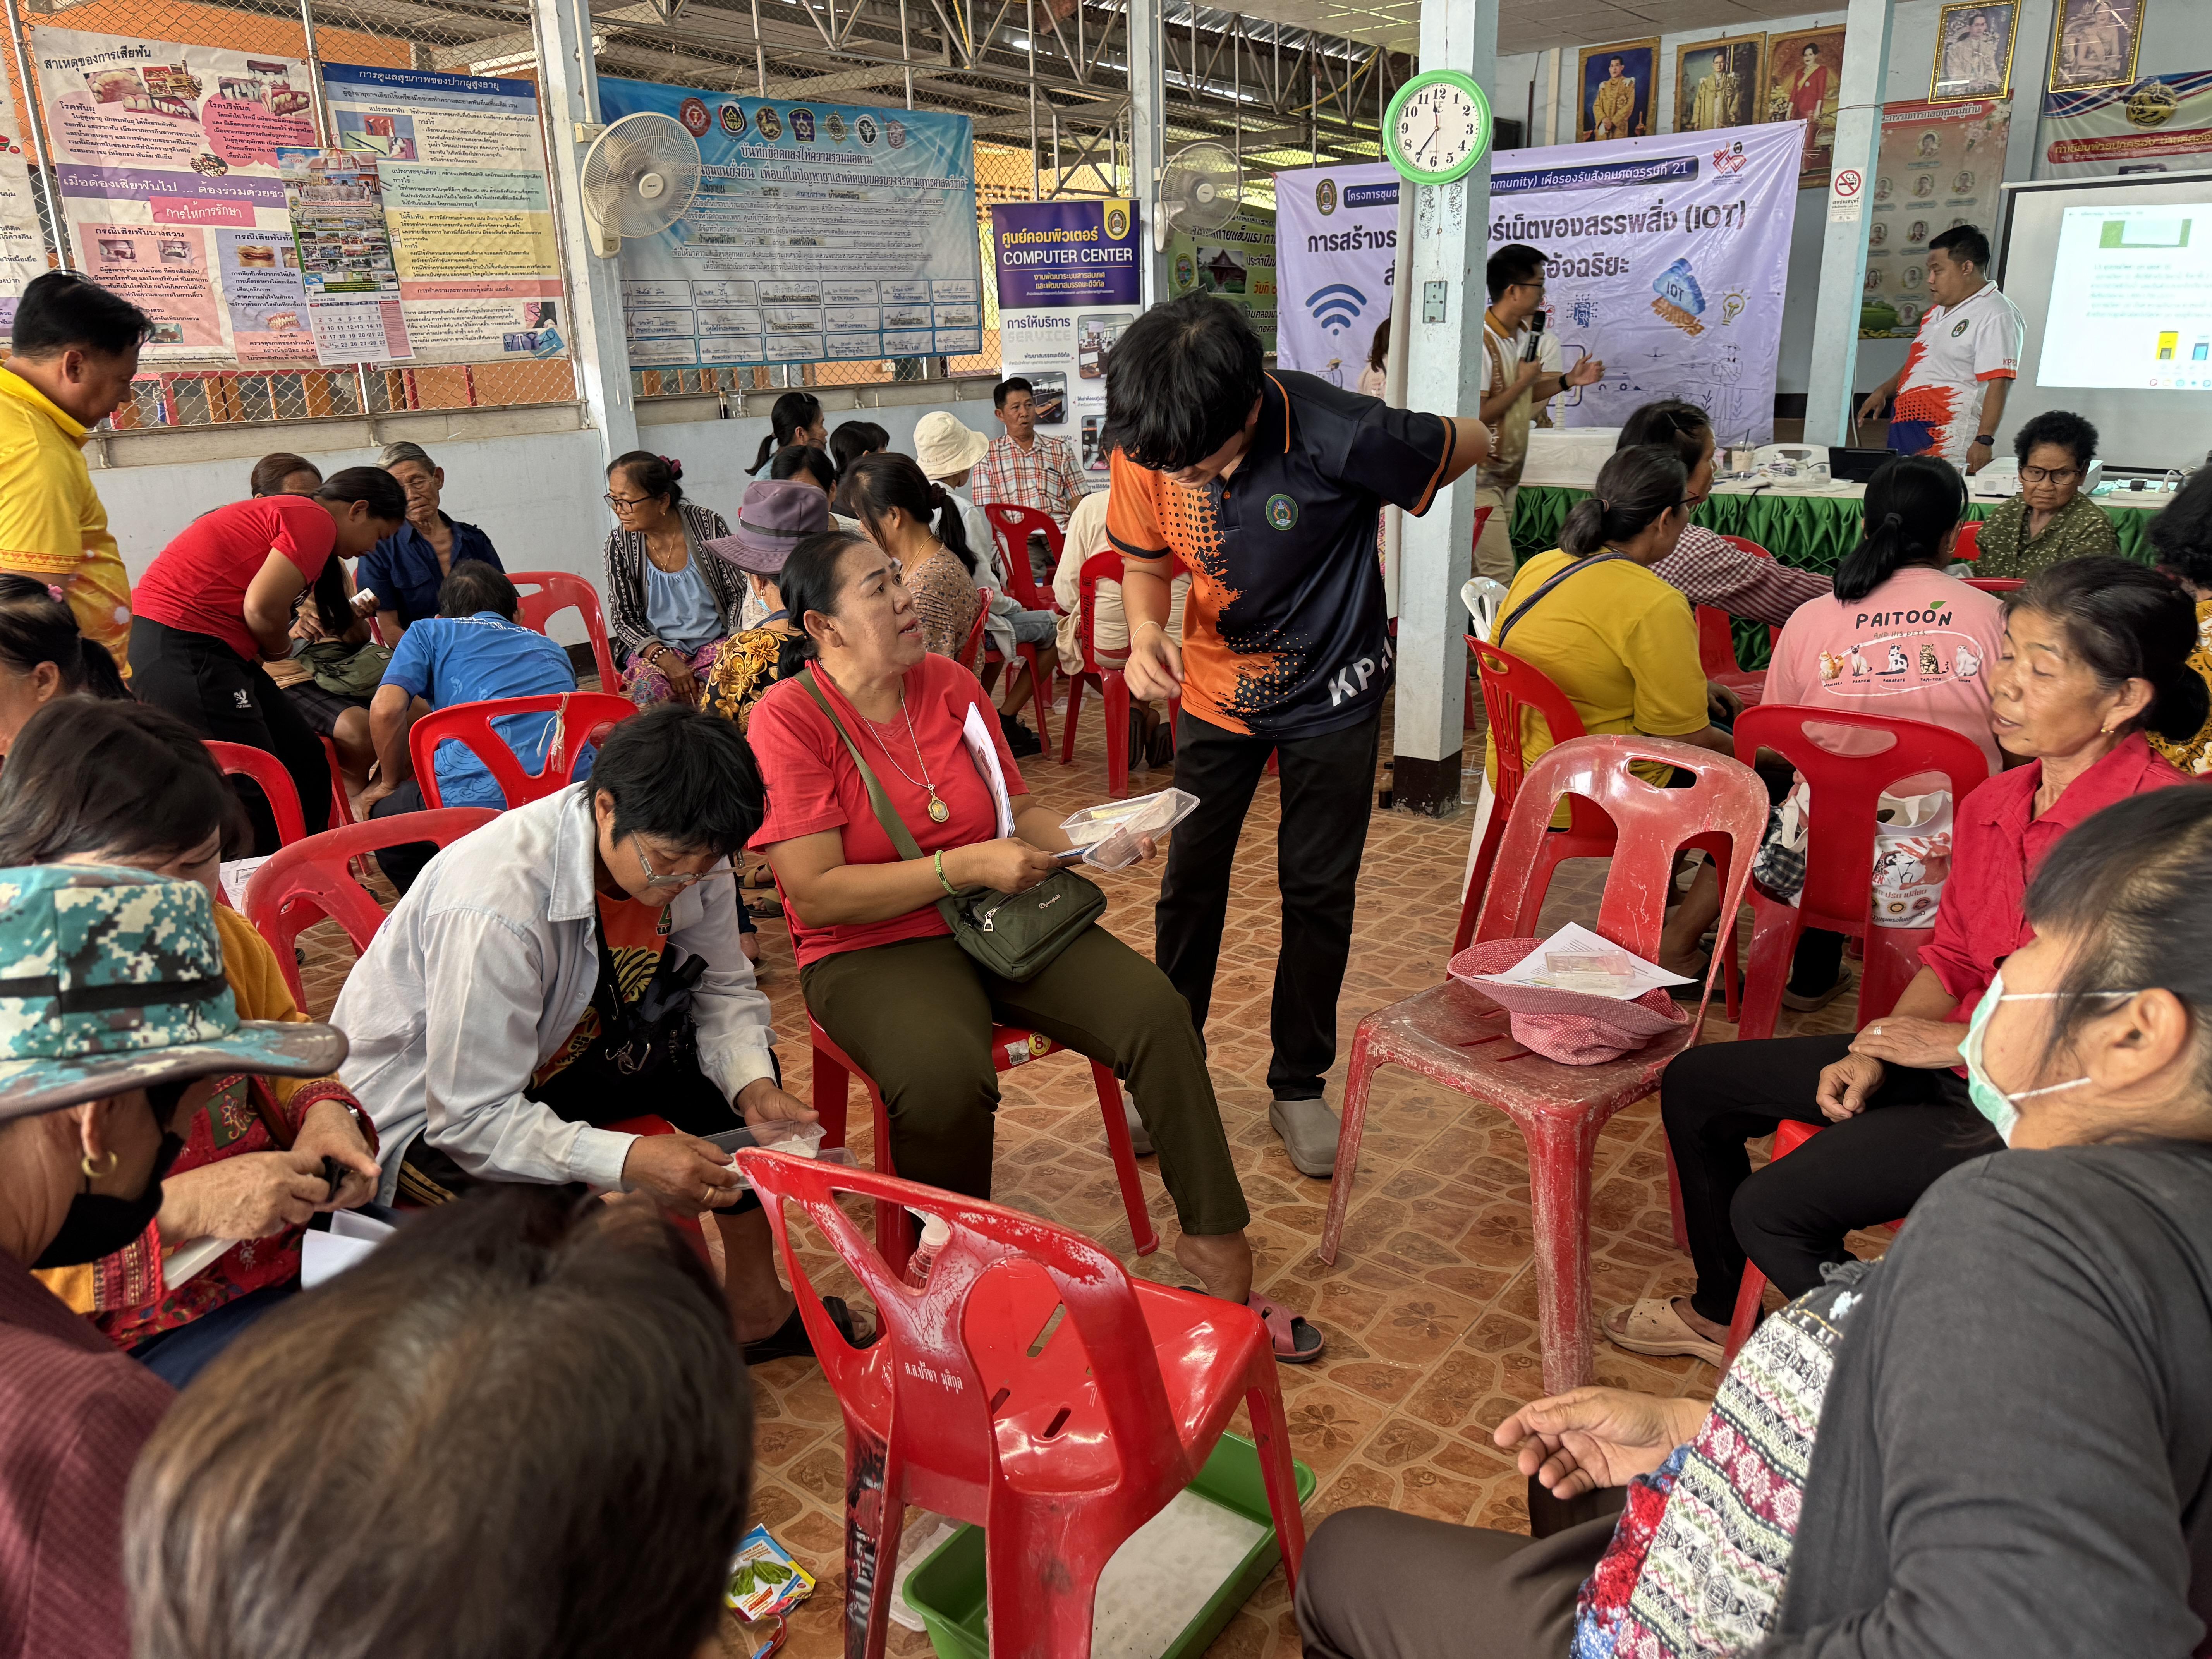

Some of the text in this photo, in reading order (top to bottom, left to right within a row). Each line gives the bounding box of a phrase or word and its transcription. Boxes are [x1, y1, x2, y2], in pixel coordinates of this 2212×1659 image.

[1417, 93, 1429, 105] 11
[1432, 88, 1446, 100] 12
[1453, 93, 1459, 104] 1
[59, 101, 96, 114] โรคฟันผุ
[1404, 106, 1418, 118] 10
[1462, 105, 1471, 117] 2
[1401, 122, 1409, 134] 9
[1466, 123, 1474, 135] 3
[1403, 139, 1412, 151] 8
[1458, 139, 1466, 151] 4
[740, 143, 874, 165] บันทึกข้อตกลงให้ความร่วมมือตาม
[1415, 151, 1423, 163] 7
[1446, 152, 1454, 164] 5
[1430, 156, 1437, 167] 6
[1672, 162, 1688, 175] 21
[166, 201, 242, 219] การให้การรักษา
[1685, 200, 1746, 233] (IOT)
[1002, 226, 1099, 249] ศูนย์คอมพิวเตอร์
[1003, 248, 1133, 265] COMPUTER CENTER
[1541, 252, 1630, 279] อัจฉริยะ
[1034, 272, 1105, 280] งานพัฒนาระบบสารสนเทศ
[1666, 281, 1685, 302] IOT
[1007, 315, 1071, 329] การให้บริการ
[1008, 330, 1071, 343] SERVICE
[1856, 610, 1952, 629] PAITOON
[1034, 1036, 1044, 1050] 8
[904, 1360, 963, 1395] ส.ส.ปรีชา มุสิกุล
